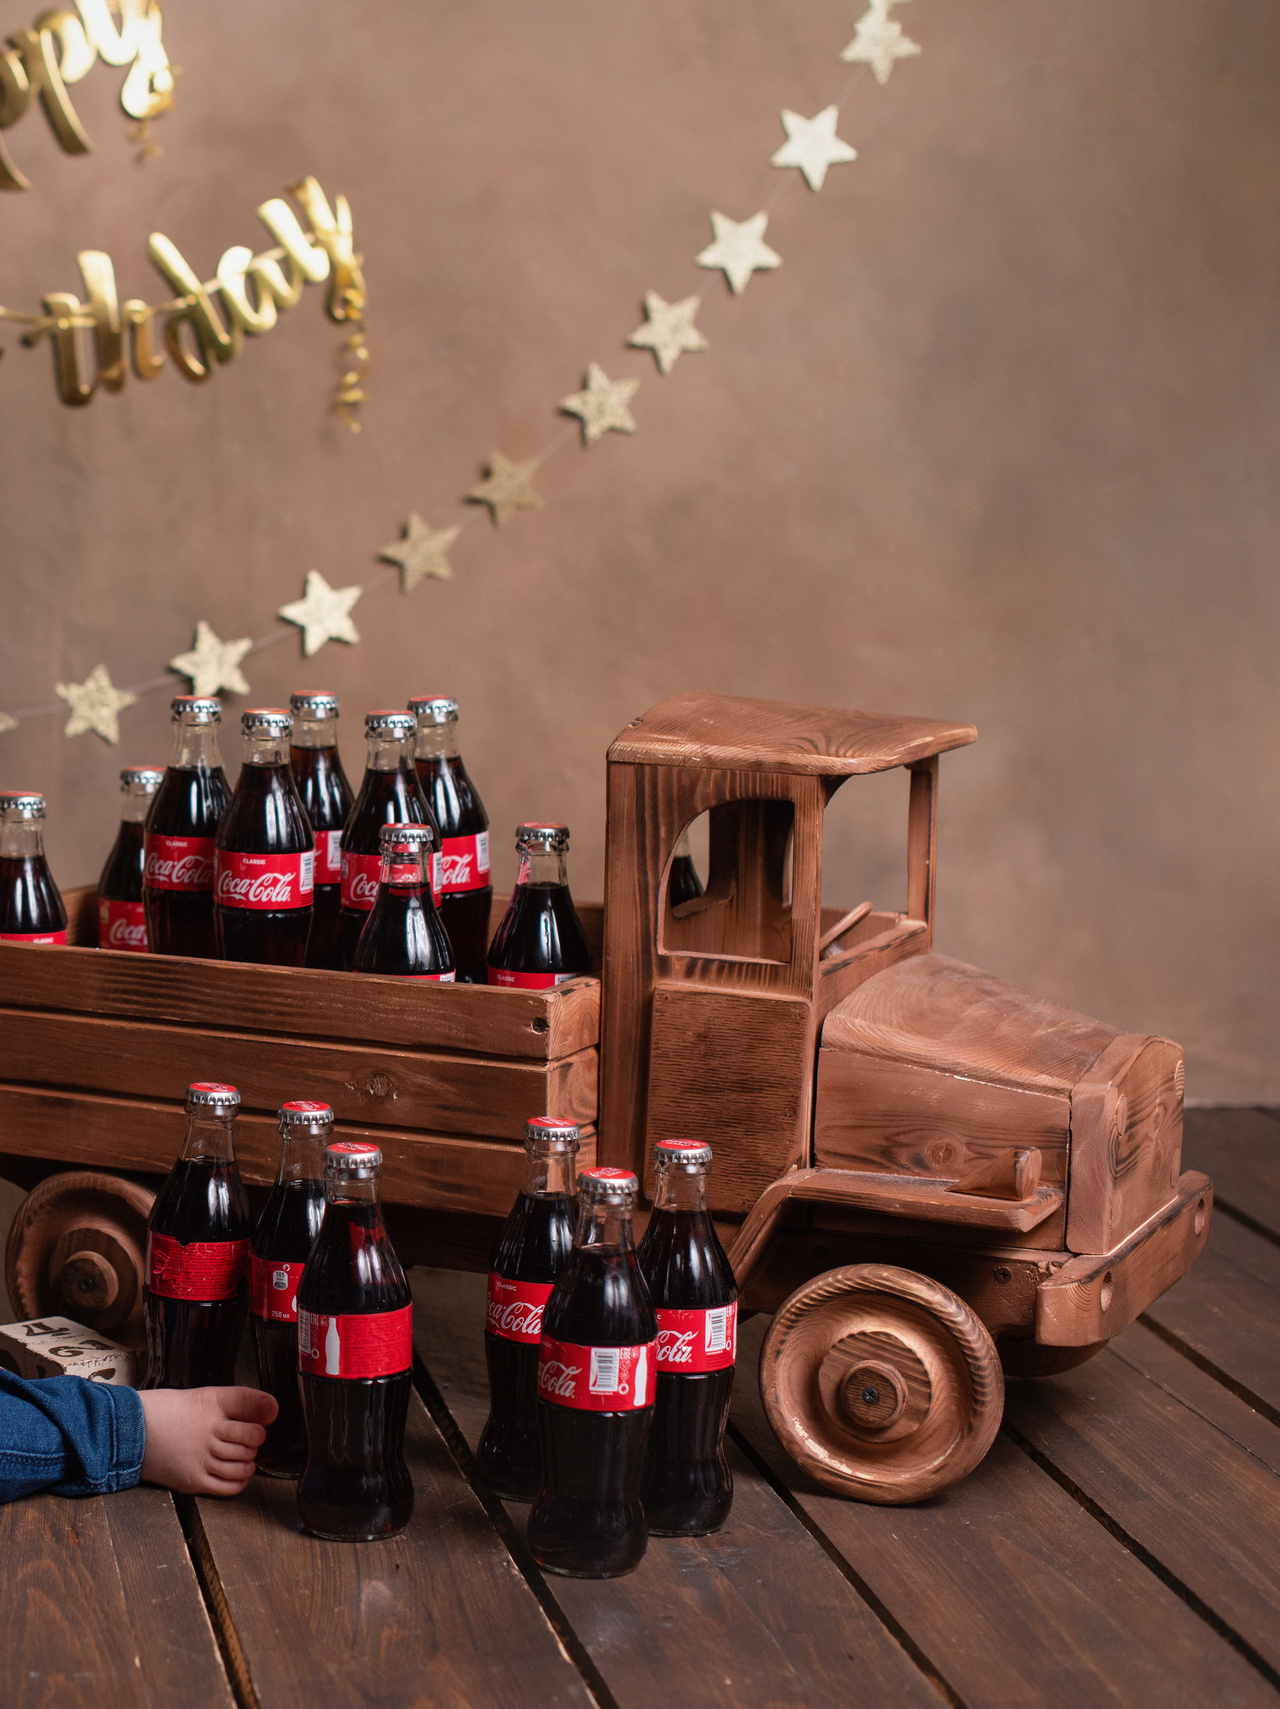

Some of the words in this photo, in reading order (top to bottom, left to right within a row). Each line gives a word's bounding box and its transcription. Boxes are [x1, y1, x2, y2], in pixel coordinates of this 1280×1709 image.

[218, 870, 296, 902] Coca-Cola
[497, 1281, 517, 1291] CLASSIC
[271, 1310, 283, 1318] 250
